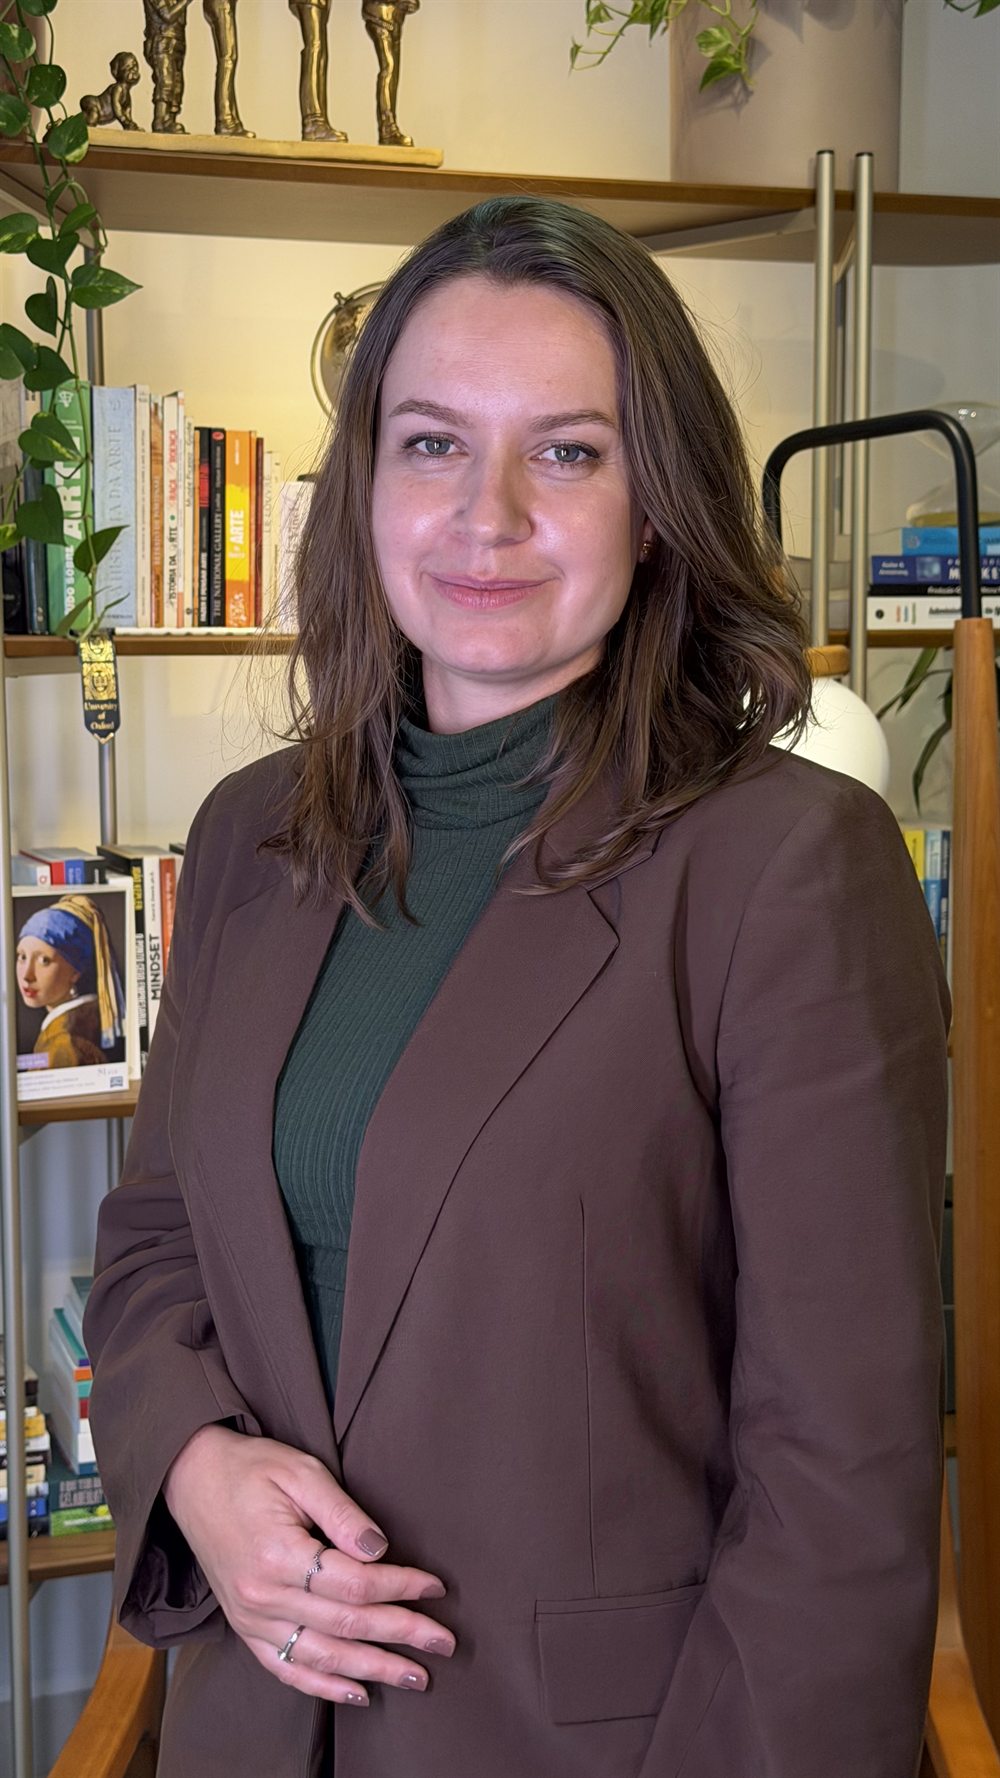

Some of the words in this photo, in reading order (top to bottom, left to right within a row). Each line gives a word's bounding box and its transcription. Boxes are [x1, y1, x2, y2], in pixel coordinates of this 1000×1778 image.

[107, 425, 121, 471] ARTE
[54, 436, 81, 540] ART
[213, 513, 222, 551] GALLERY
[229, 509, 244, 545] ARTE
[64, 545, 75, 584] SOBRE
[213, 552, 221, 597] NATIONAL
[213, 600, 221, 617] THE
[90, 721, 114, 730] Oxford
[149, 933, 161, 1001] MINDSET
